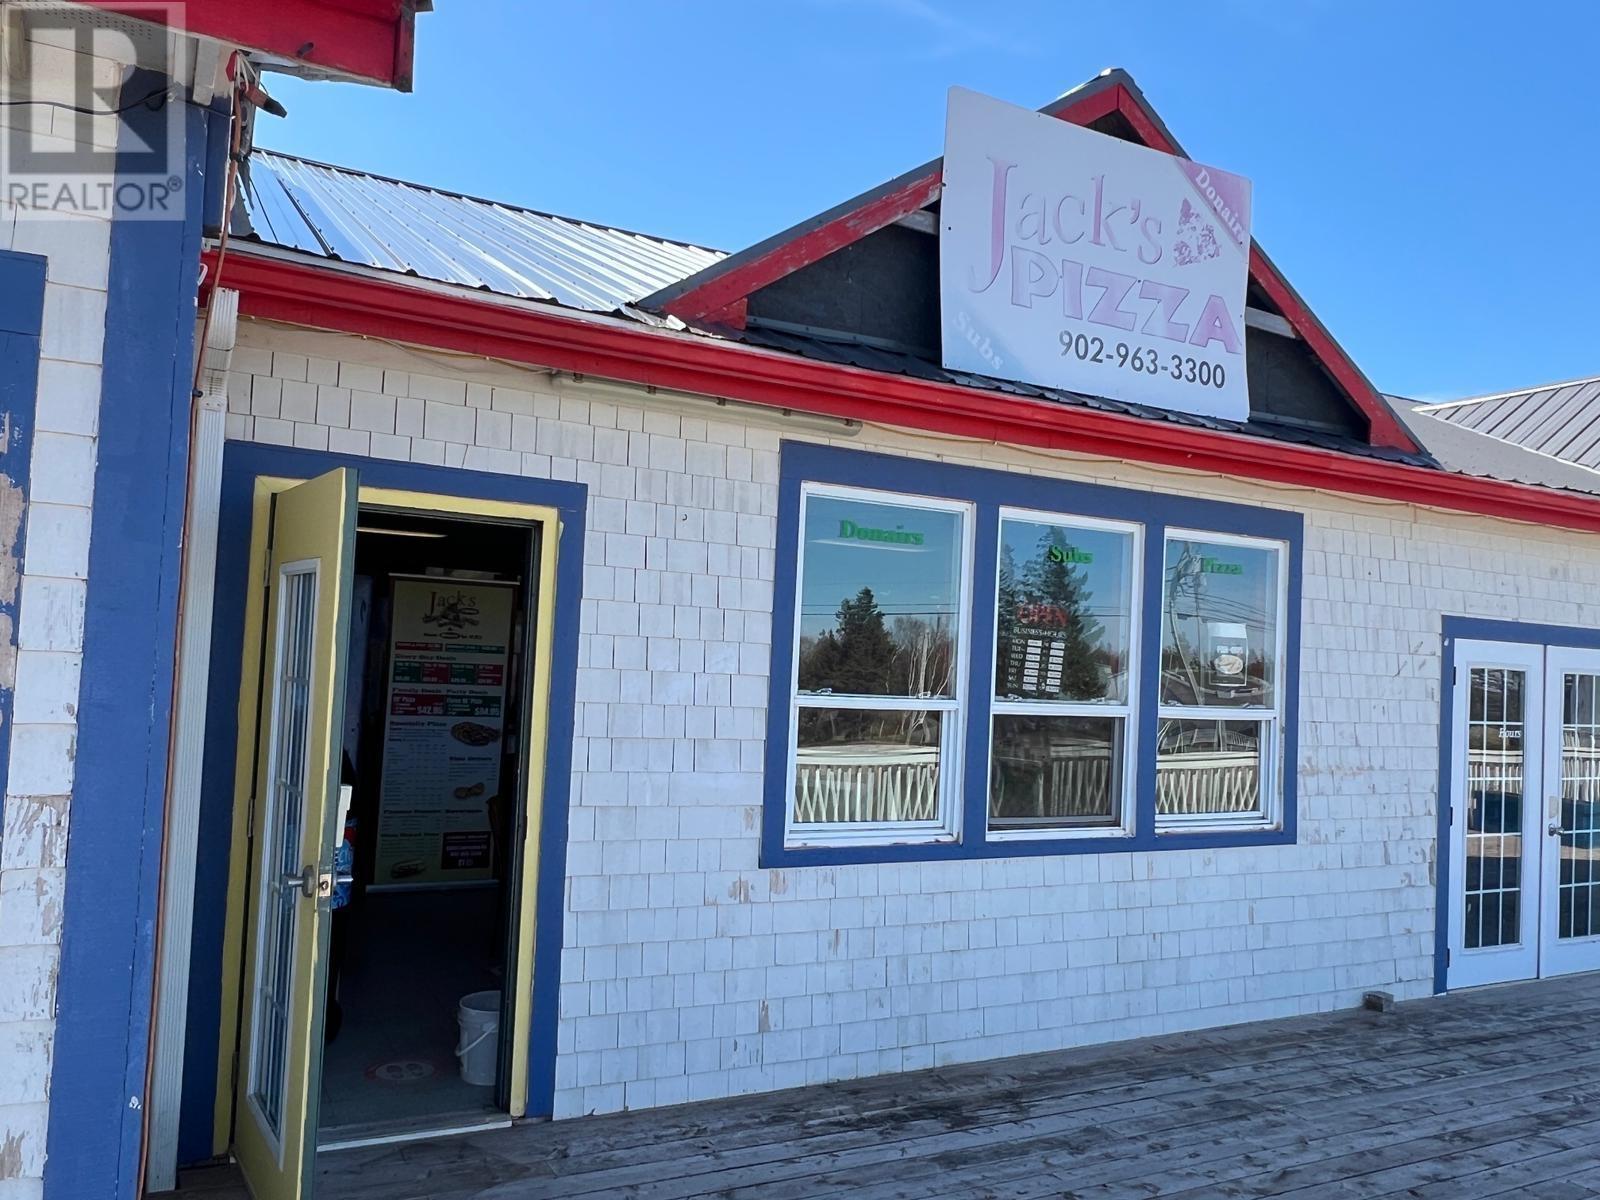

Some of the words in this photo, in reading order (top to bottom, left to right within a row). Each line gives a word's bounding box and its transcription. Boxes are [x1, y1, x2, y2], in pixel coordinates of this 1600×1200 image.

[967, 154, 1162, 294] Jack's
[952, 310, 1004, 370] Subs
[1010, 245, 1242, 355] PIZZA
[1058, 329, 1226, 389] 902-963-3300
